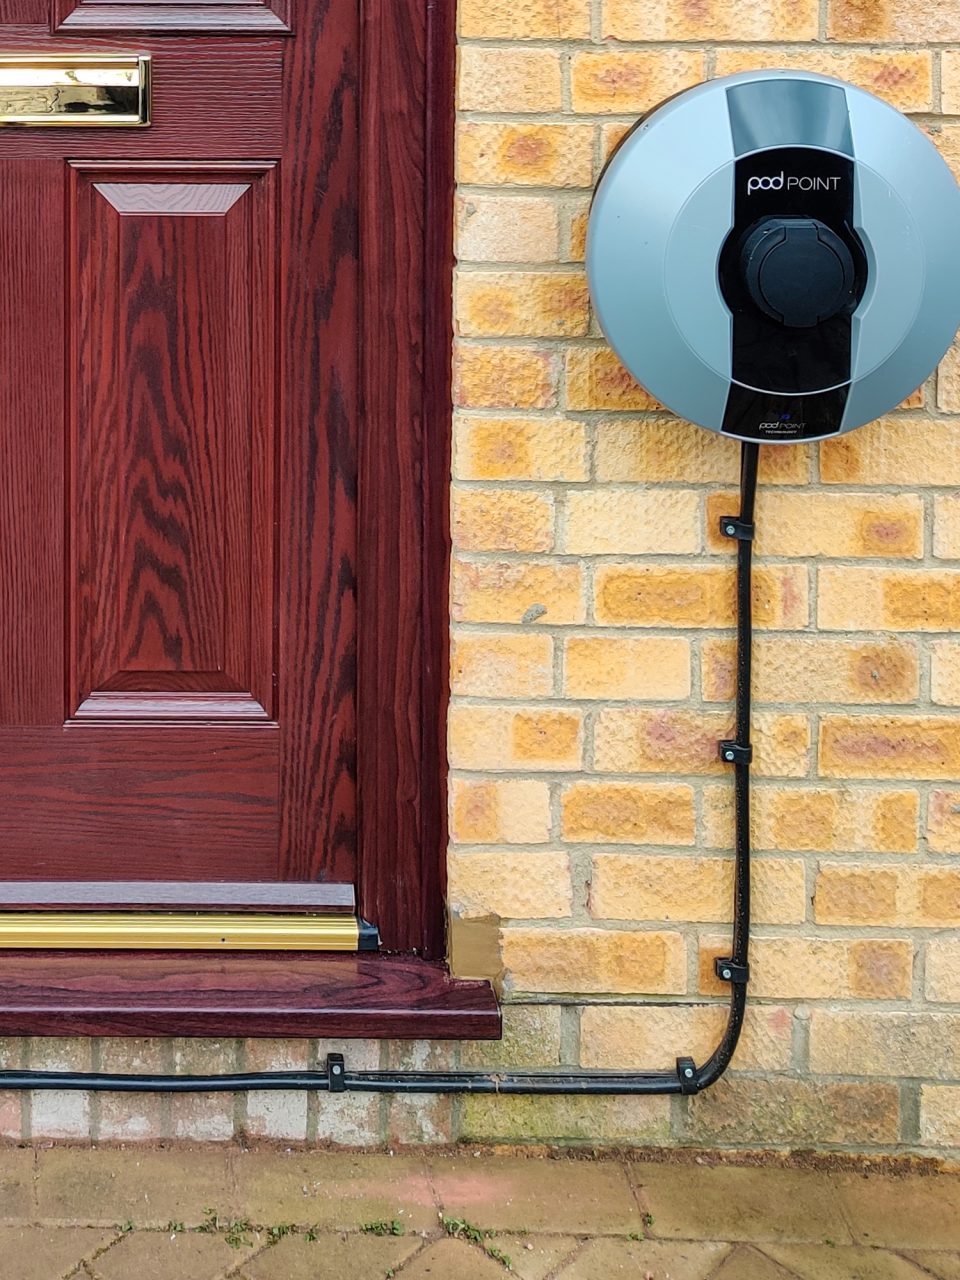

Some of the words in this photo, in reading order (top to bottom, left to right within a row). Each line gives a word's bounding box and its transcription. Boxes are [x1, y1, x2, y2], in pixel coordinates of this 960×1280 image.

[747, 171, 784, 196] pod
[787, 177, 841, 191] POINT
[759, 422, 780, 430] pod
